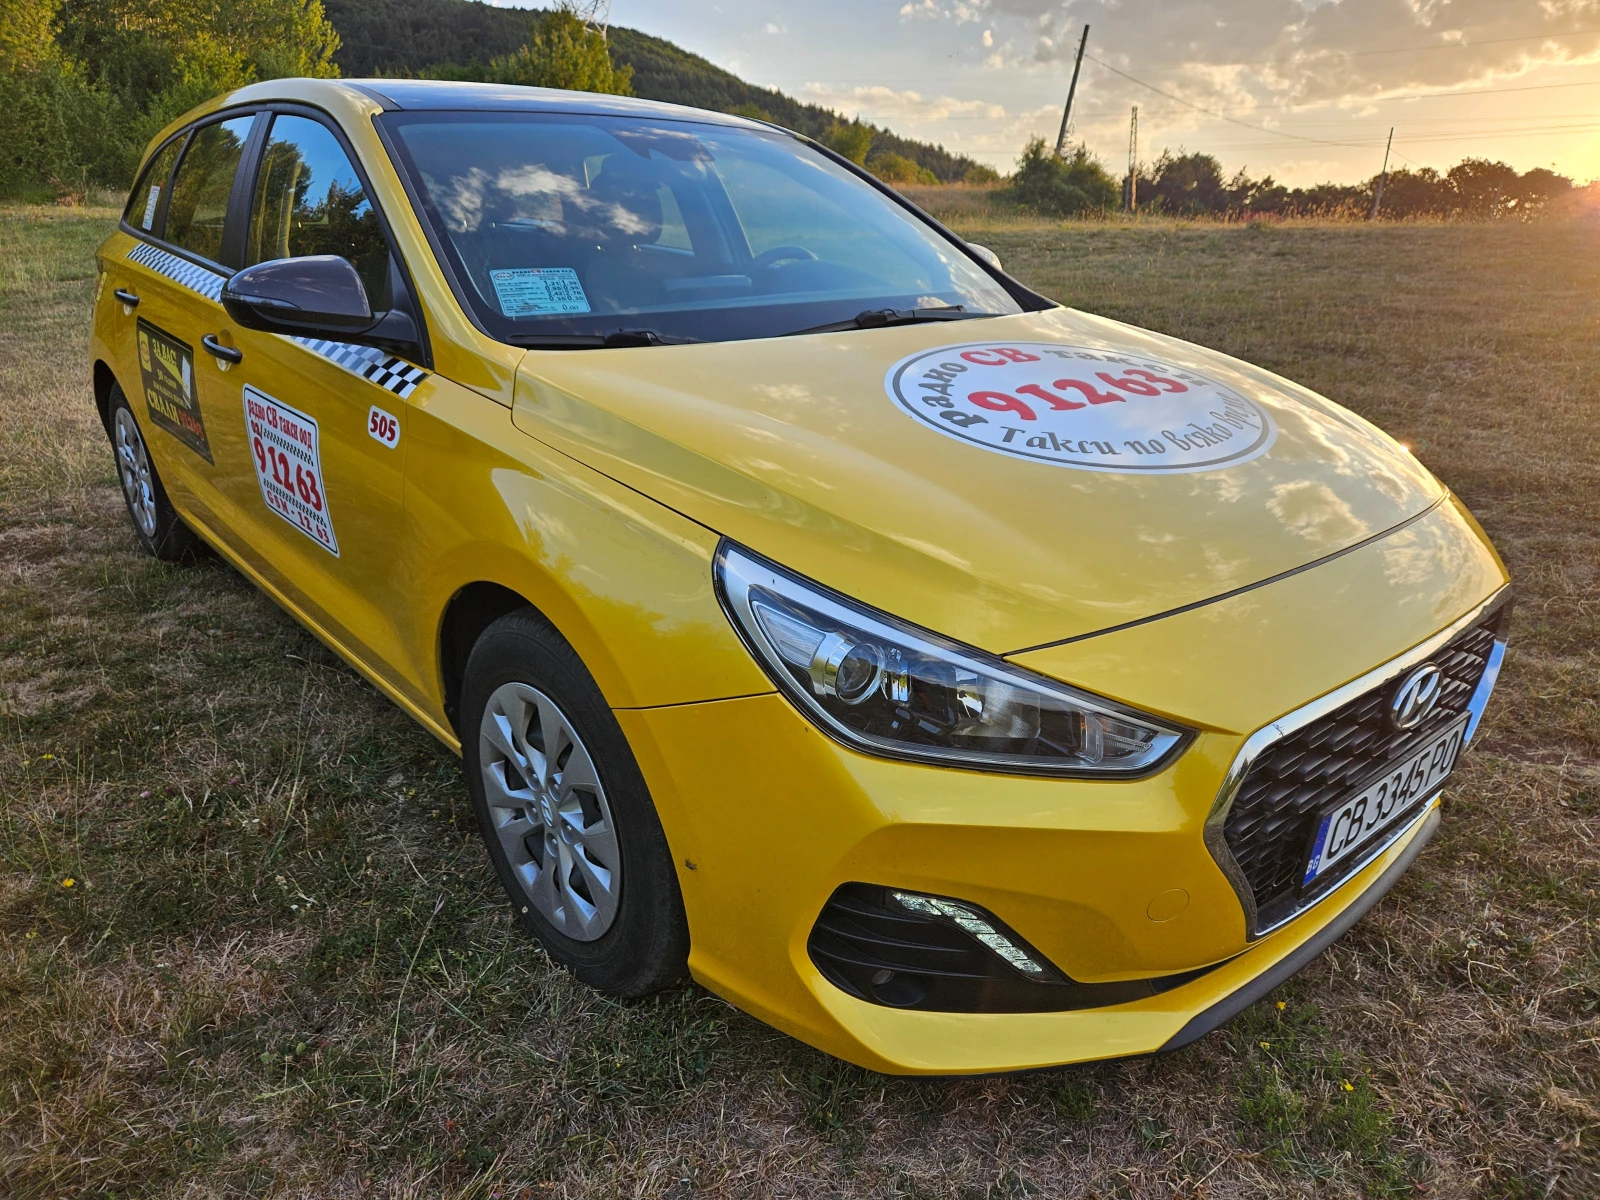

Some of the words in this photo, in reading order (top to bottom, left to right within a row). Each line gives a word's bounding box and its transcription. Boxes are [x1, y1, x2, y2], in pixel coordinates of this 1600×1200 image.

[966, 368, 1190, 421] 91263
[266, 405, 278, 429] СВ
[370, 411, 396, 442] 505
[1306, 854, 1321, 875] BG
